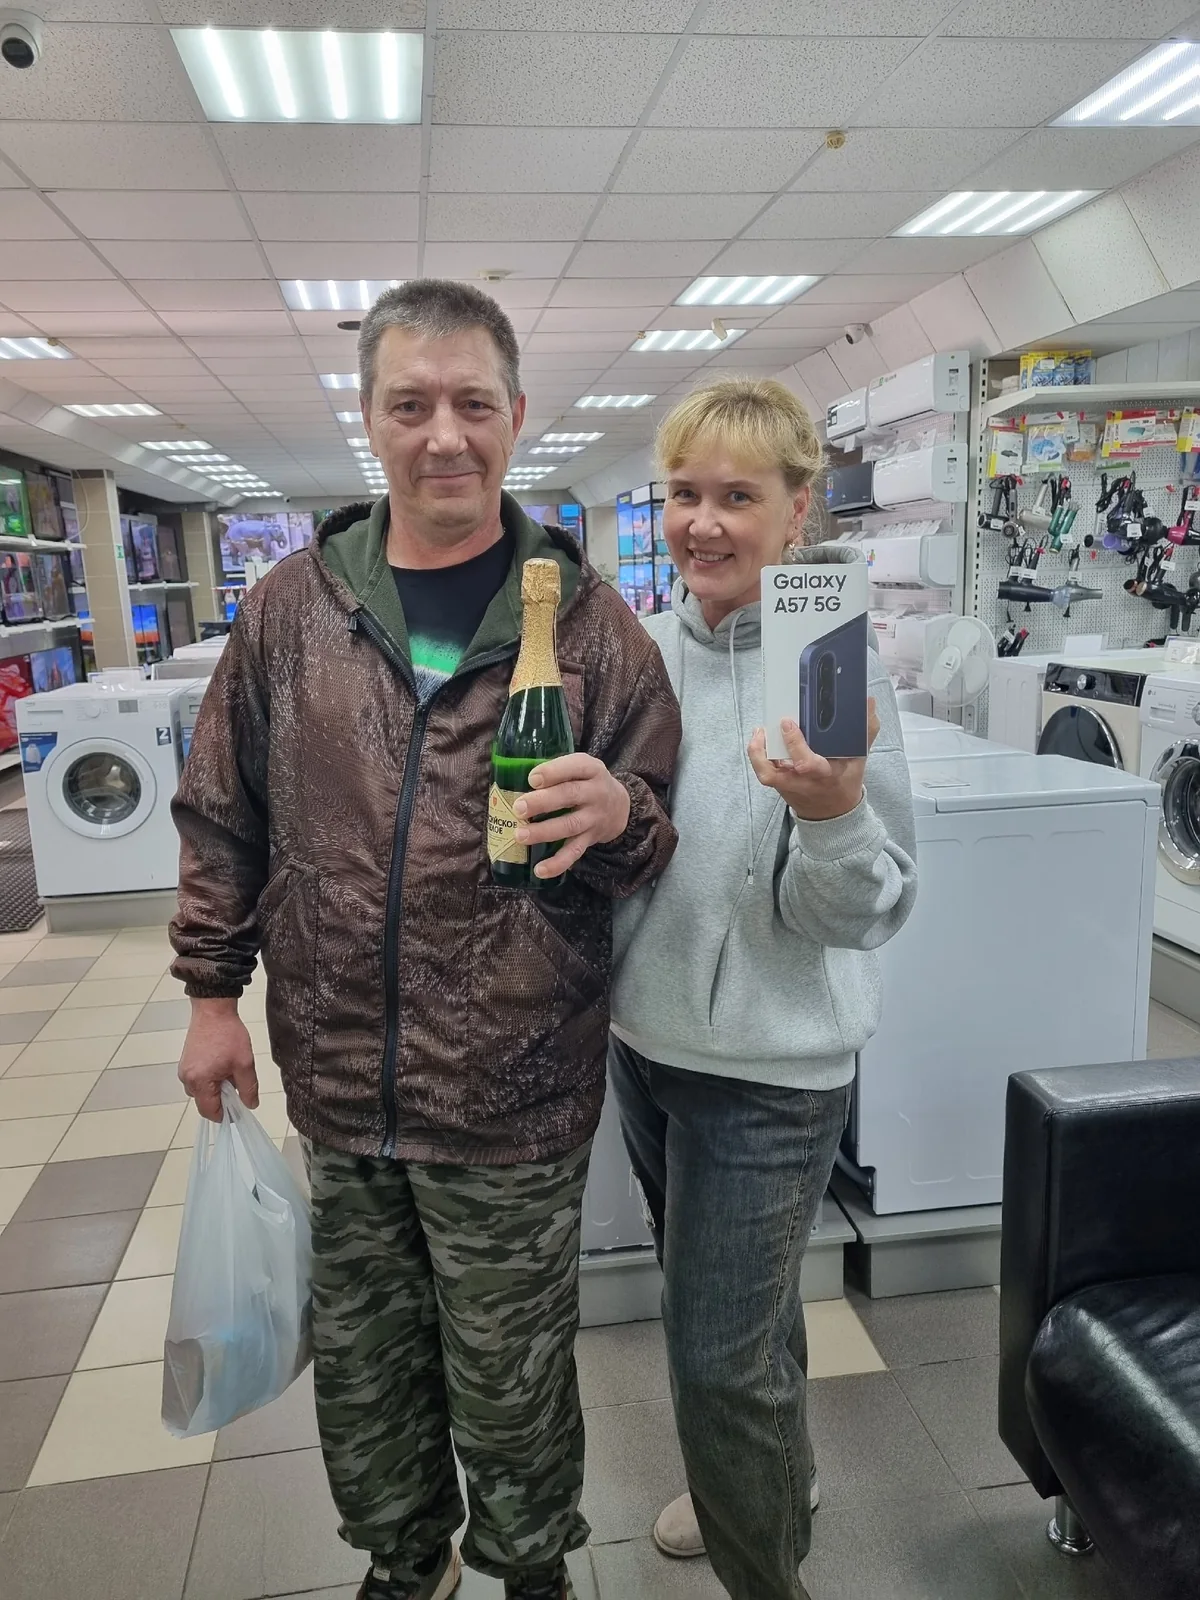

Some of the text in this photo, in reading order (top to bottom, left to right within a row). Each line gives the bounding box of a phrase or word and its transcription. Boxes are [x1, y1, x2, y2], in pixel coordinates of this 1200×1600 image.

[773, 573, 847, 592] Galaxy
[774, 596, 841, 613] A57 5G
[158, 728, 169, 740] 2
